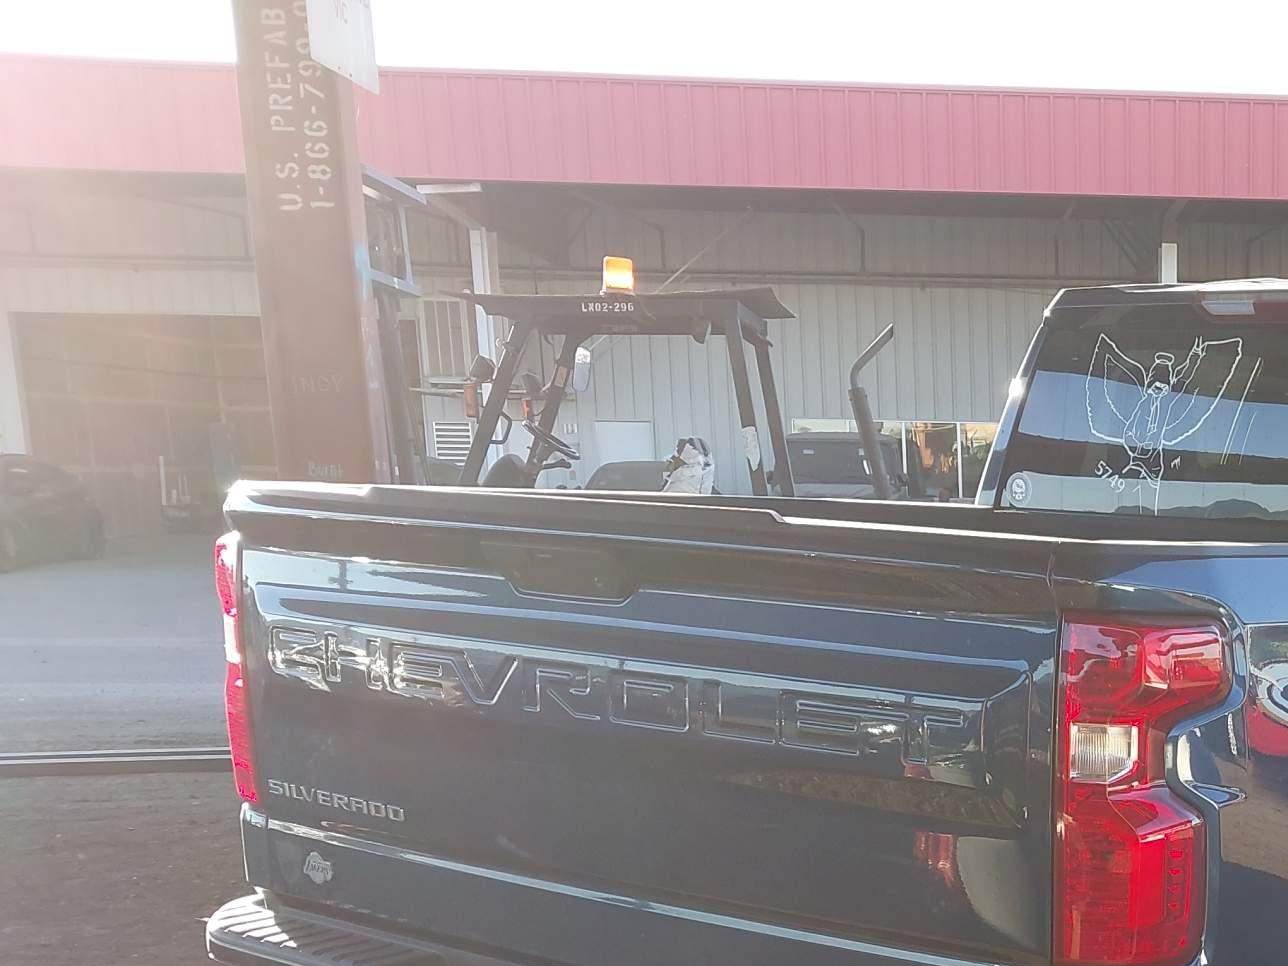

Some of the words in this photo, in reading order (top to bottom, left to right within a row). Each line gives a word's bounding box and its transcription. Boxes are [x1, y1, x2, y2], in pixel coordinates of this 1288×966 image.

[260, 7, 296, 132] PREFAB
[275, 152, 303, 211] U.S.
[268, 624, 965, 767] CHEVROLET
[268, 778, 405, 822] SILVERADO
